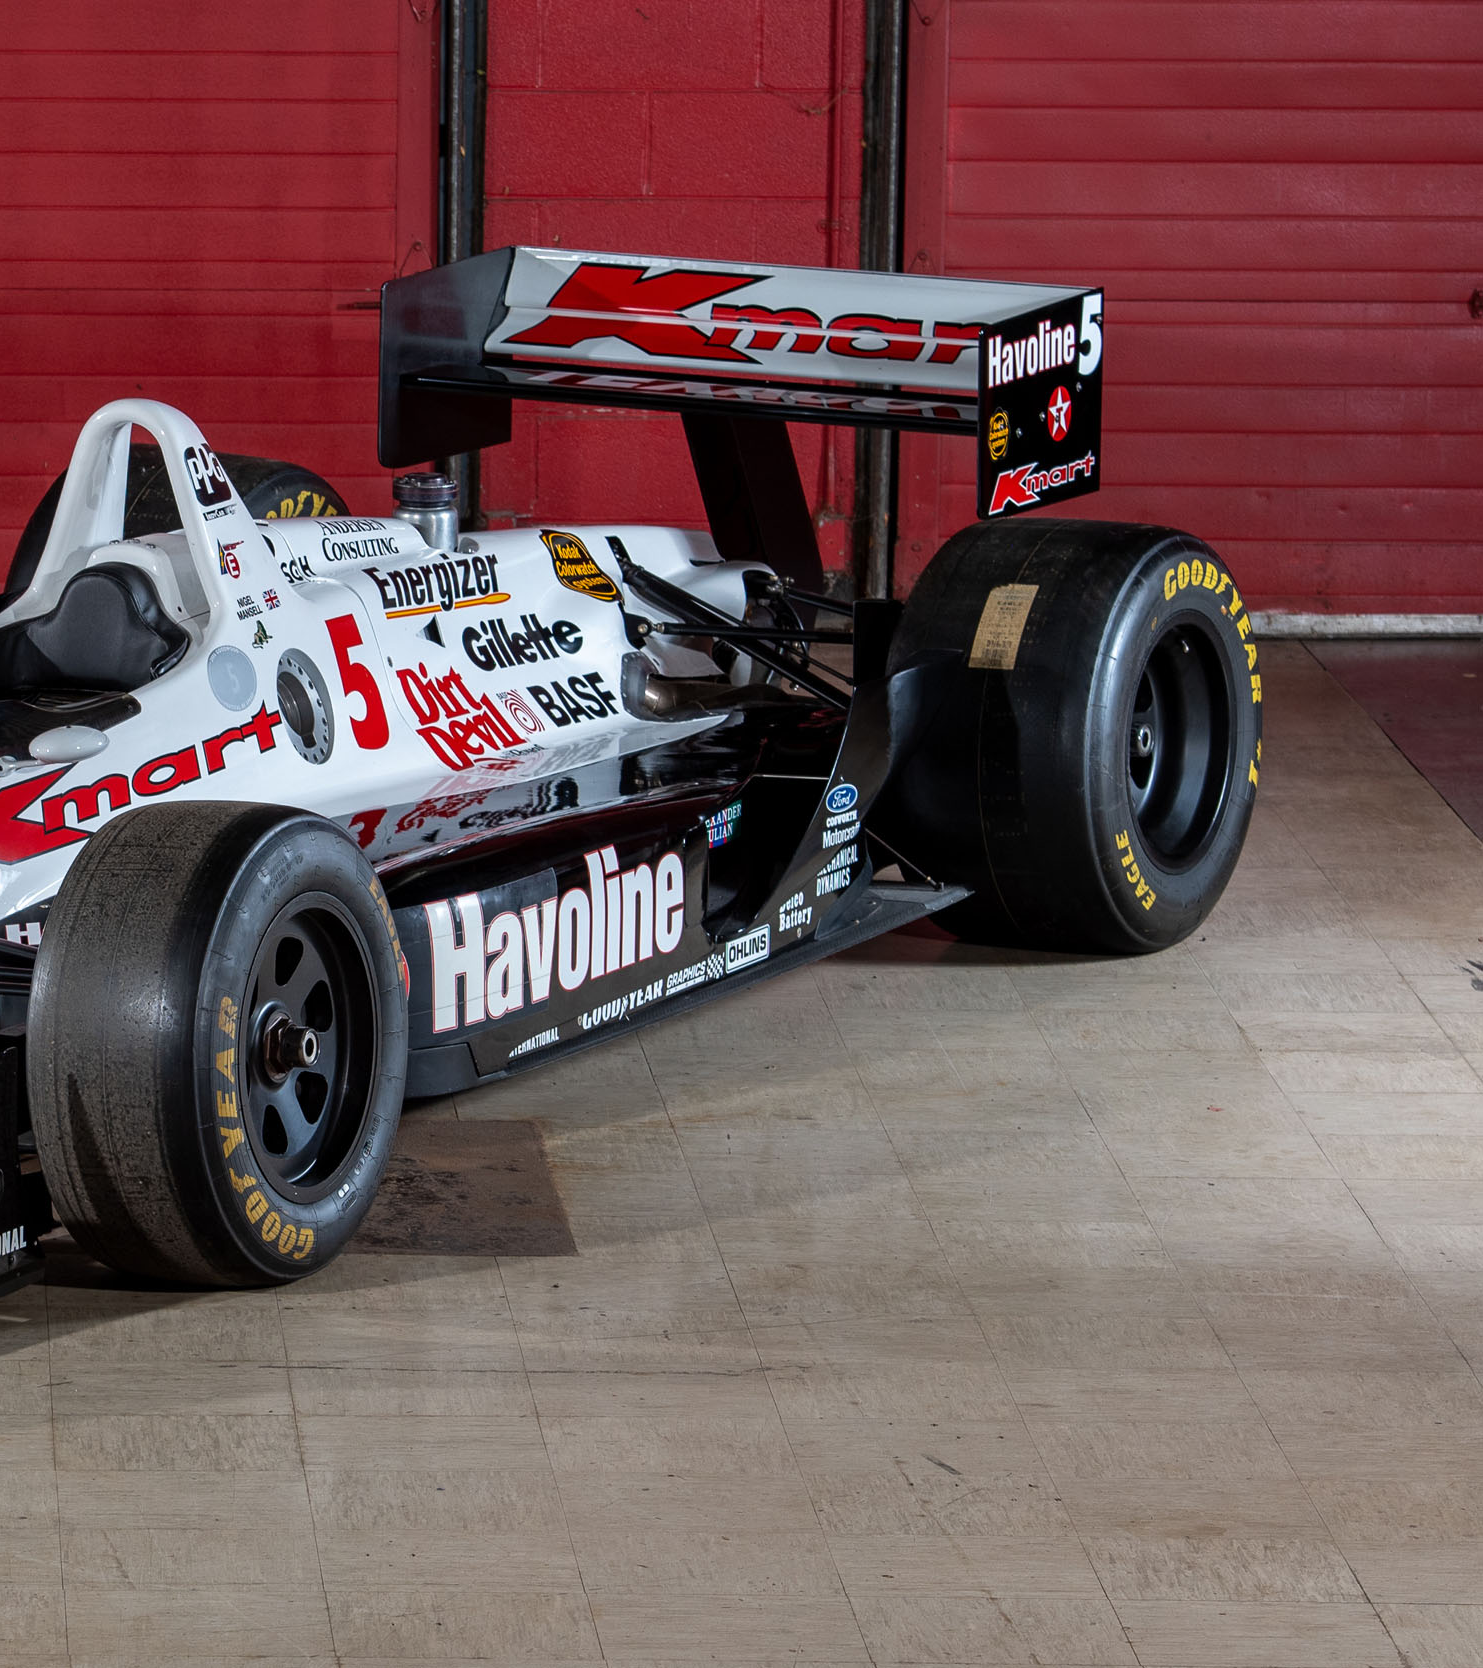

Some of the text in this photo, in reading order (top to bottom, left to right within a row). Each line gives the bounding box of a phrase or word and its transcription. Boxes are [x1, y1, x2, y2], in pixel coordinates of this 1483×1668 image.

[501, 264, 979, 364] Kmar
[988, 319, 1075, 388] Havoline
[1078, 293, 1102, 376] 5
[988, 450, 1095, 515] Kmart
[316, 519, 386, 536] ANDERSEN
[322, 537, 399, 561] CONSULTING
[555, 543, 581, 559] Kodak
[556, 560, 600, 577] Colorwatch
[236, 595, 255, 608] NIGEL
[361, 553, 498, 611] Energizer
[573, 577, 609, 589] system
[236, 604, 263, 620] MANSELL
[1164, 559, 1262, 704] GOODYEAR
[462, 613, 583, 671] Gillette
[325, 613, 390, 750] 5
[396, 662, 483, 726] Dirt
[526, 671, 619, 728] BASF
[416, 693, 527, 771] Devil
[832, 790, 851, 808] Ford
[707, 822, 734, 842] ULIAN
[816, 867, 851, 897] DYNAMICS
[1115, 829, 1157, 911] EAGLE
[423, 844, 685, 1033] Havoline
[779, 906, 812, 933] Battery
[728, 933, 767, 963] ÖHLINS
[666, 960, 707, 989] GRAPHICS
[215, 996, 315, 1261] GOODYEAR
